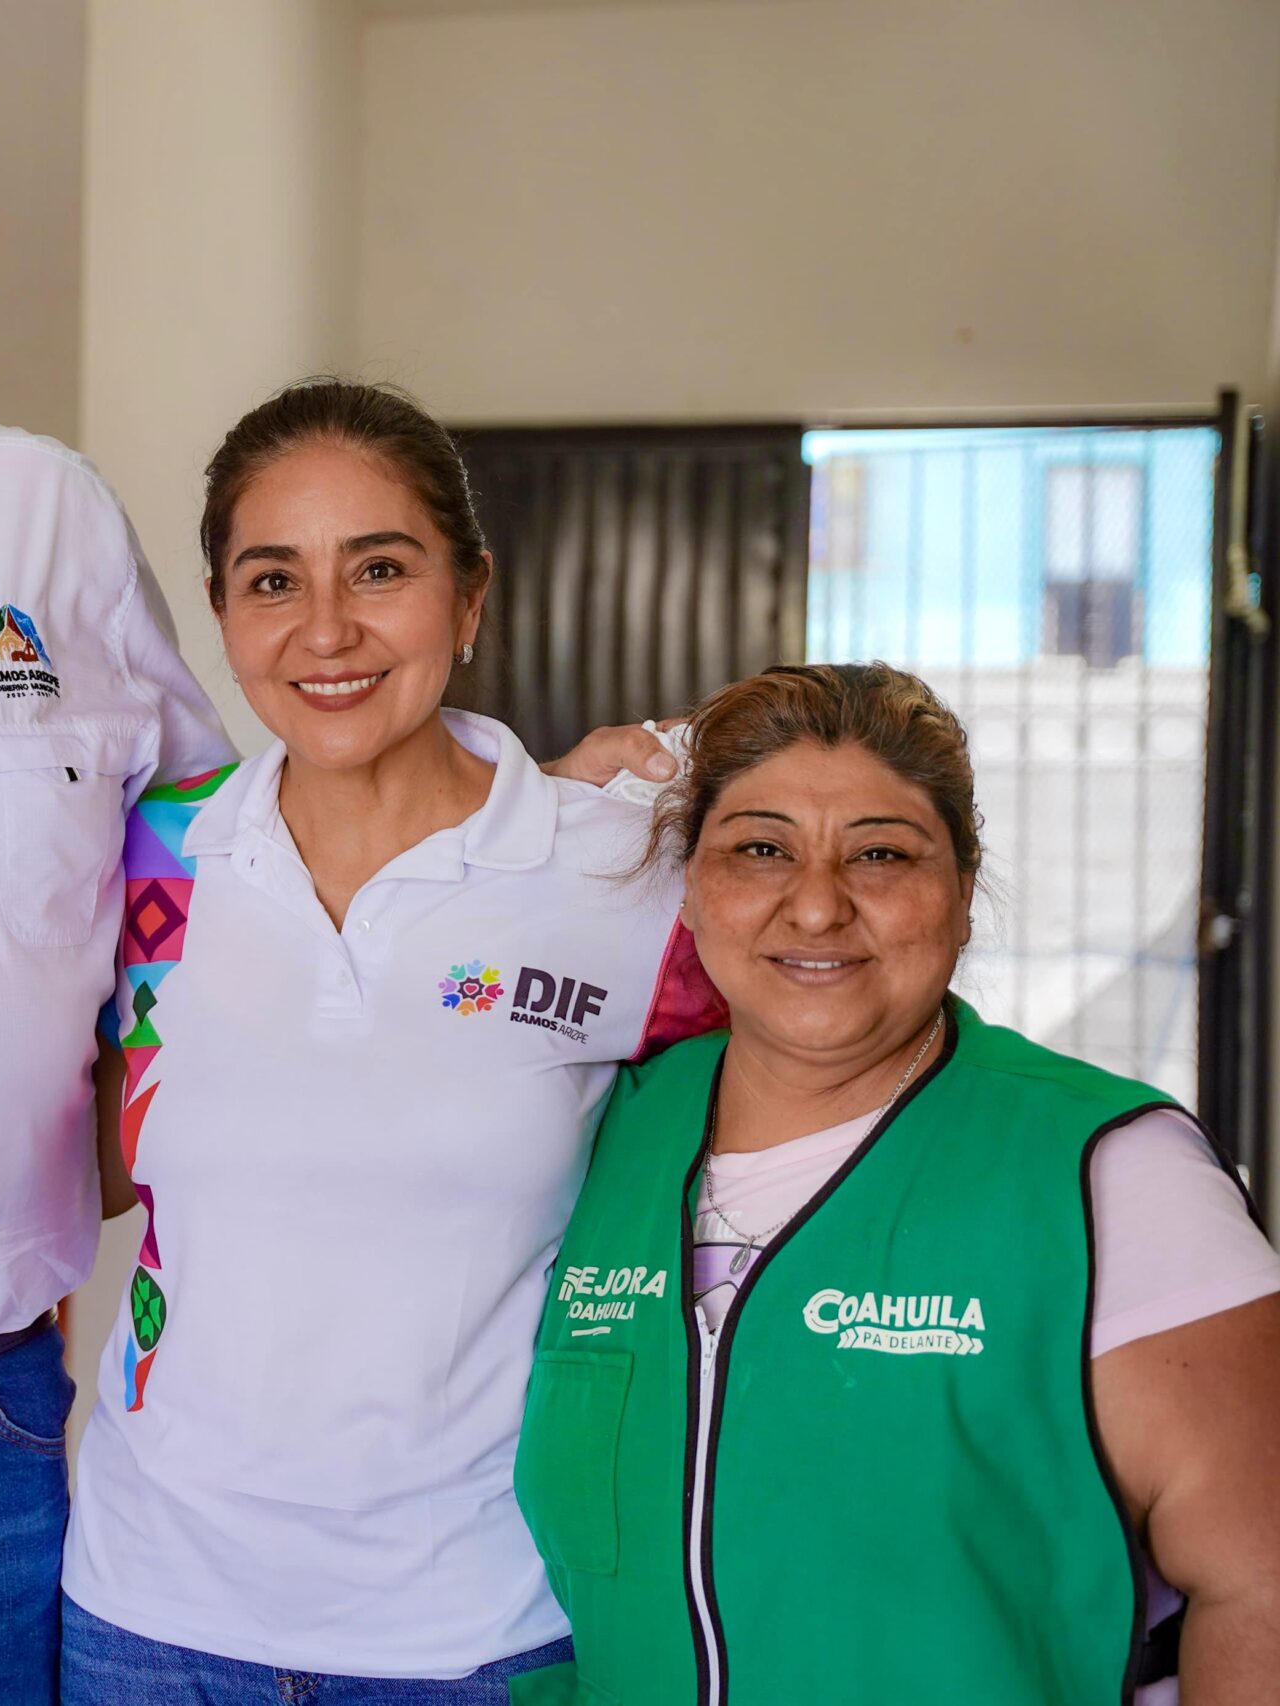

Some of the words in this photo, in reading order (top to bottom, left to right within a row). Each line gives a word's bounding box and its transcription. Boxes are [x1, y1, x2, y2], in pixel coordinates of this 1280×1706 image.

[513, 967, 608, 1026] DIF
[510, 1012, 558, 1031] RAMOS
[557, 1024, 590, 1045] ARIZPE
[802, 1287, 986, 1335] COAHUILA
[890, 1335, 953, 1350] DELANTE
